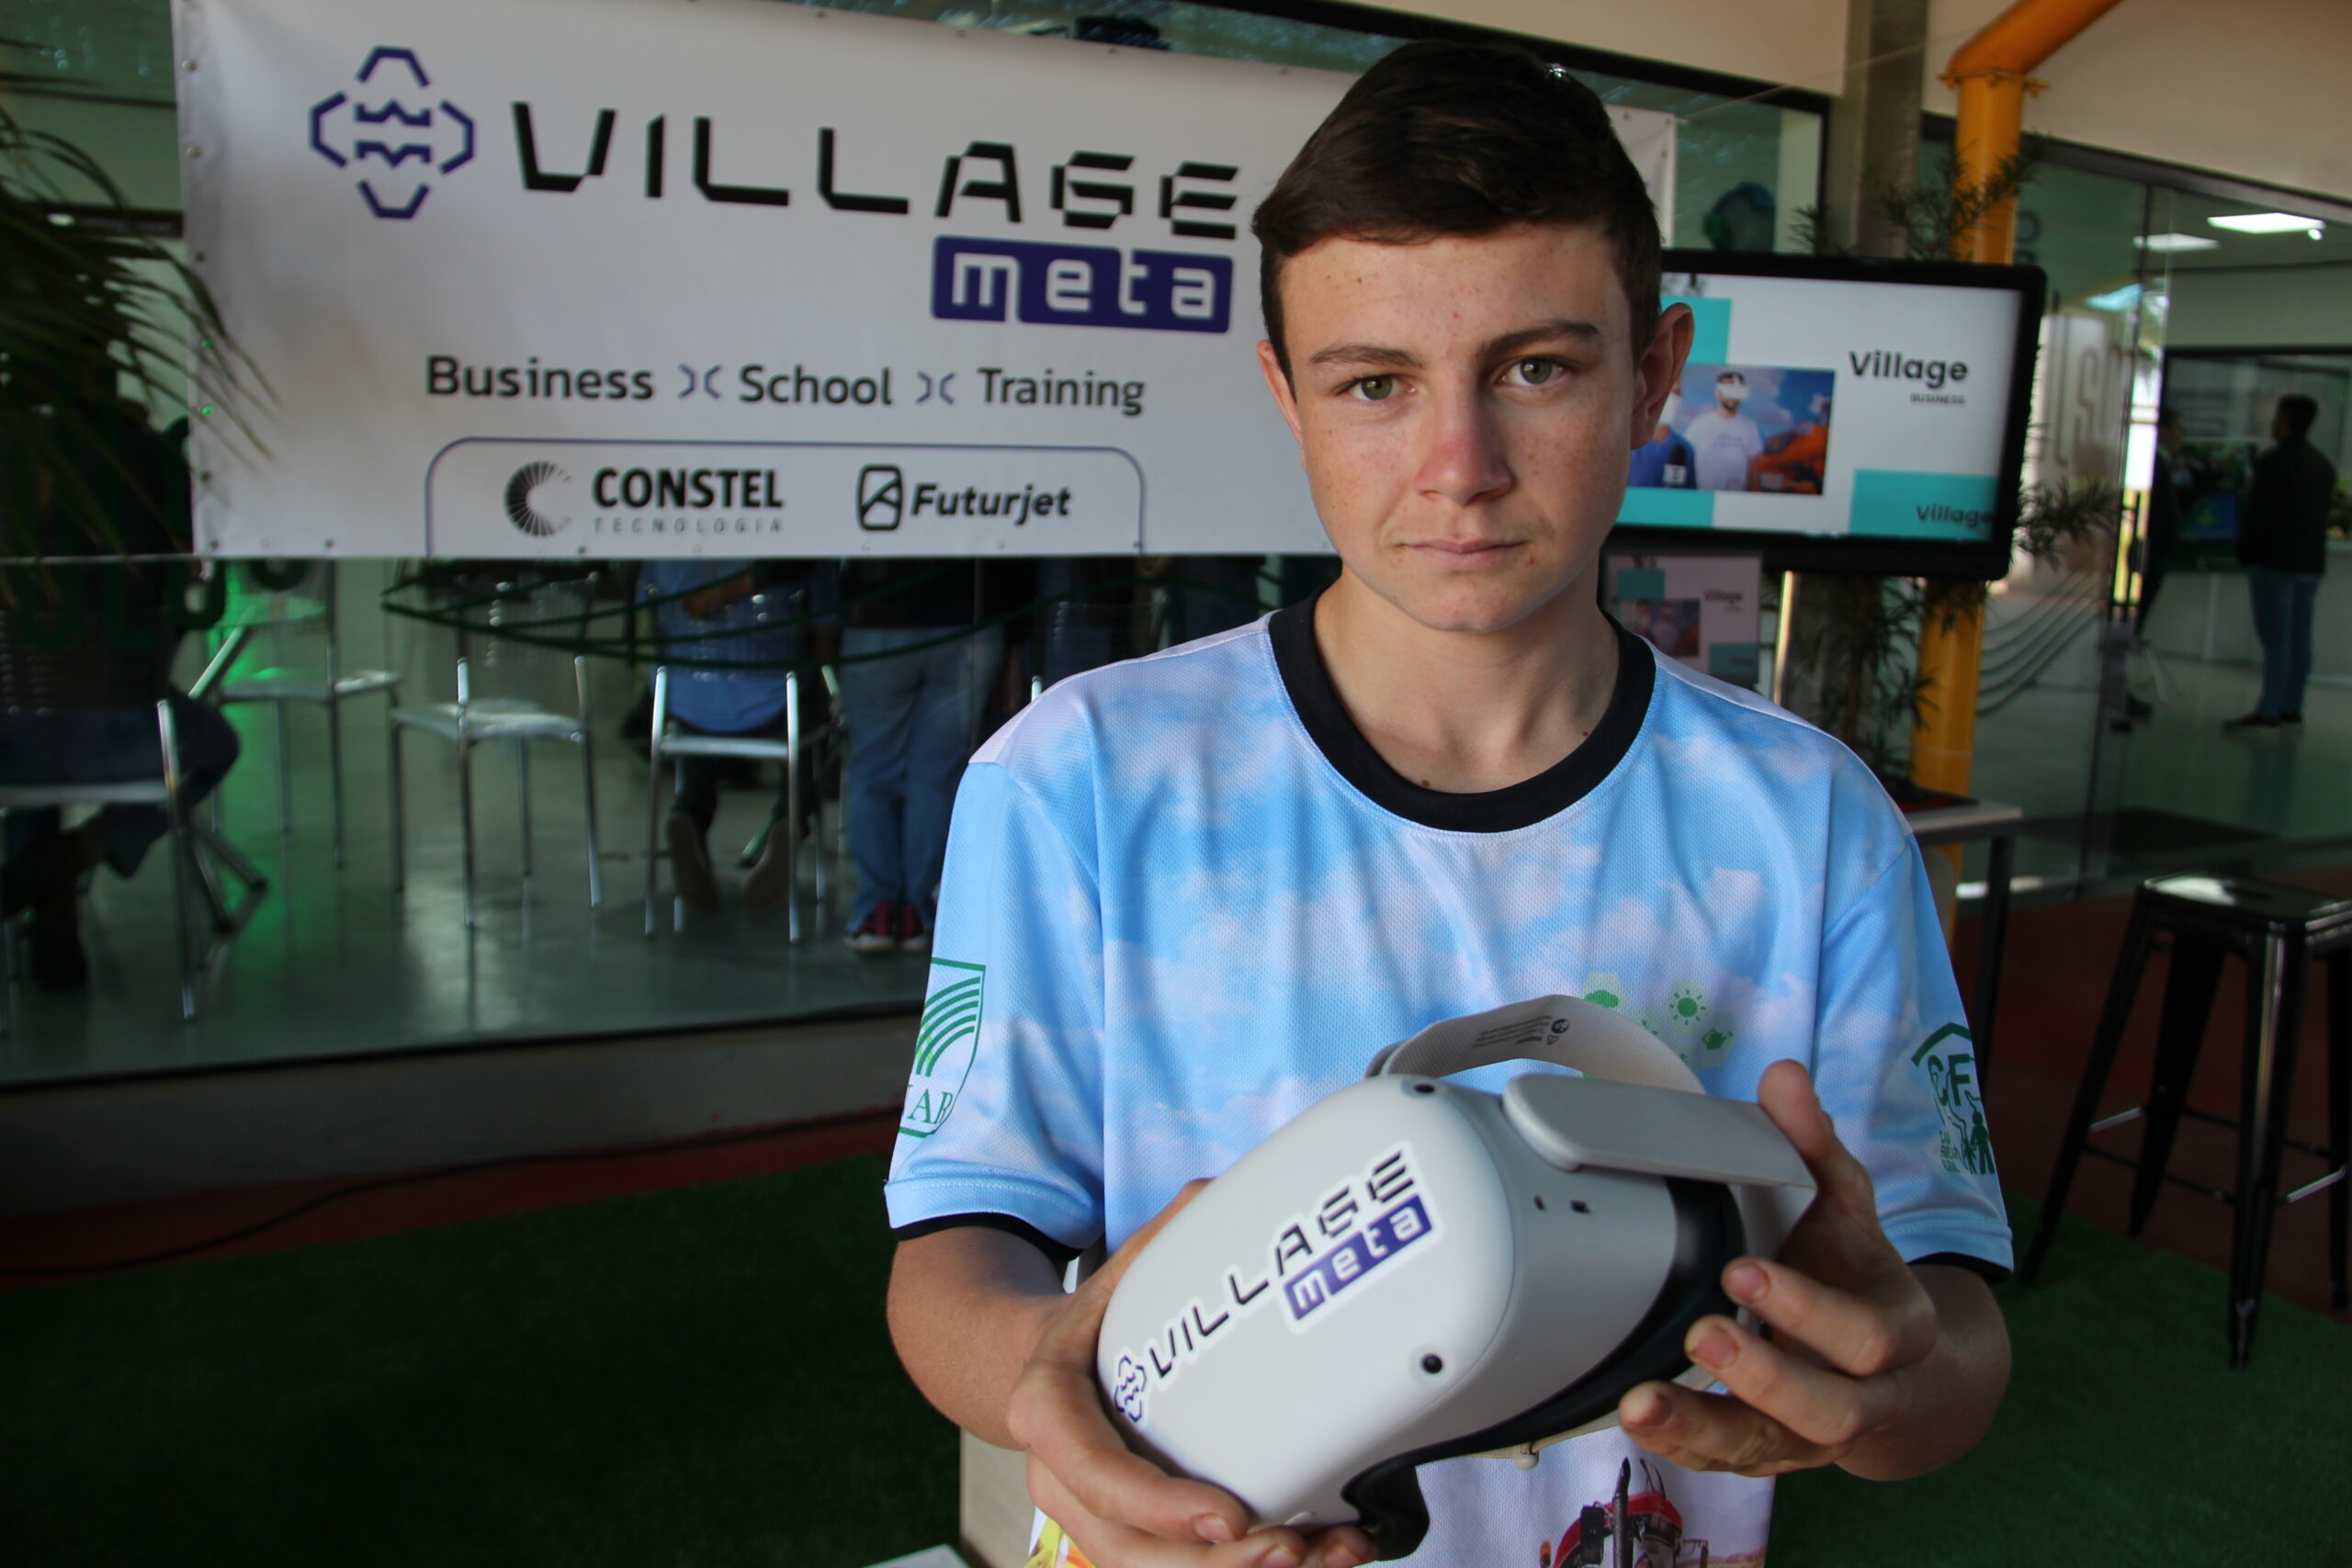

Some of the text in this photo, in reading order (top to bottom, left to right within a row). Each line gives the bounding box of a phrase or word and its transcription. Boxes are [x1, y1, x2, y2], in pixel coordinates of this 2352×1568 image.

[512, 101, 1239, 239] VILLAGE
[949, 250, 1217, 322] meta
[424, 354, 1146, 418] Business School Training
[1849, 350, 1969, 390] Village
[1910, 392, 1966, 406] BUSINESS
[592, 467, 1071, 526] CONSTEL Futurjet
[593, 516, 783, 535] TECNOLOGIA
[1148, 1150, 1415, 1379] VILLAGE
[1290, 1203, 1424, 1314] meta
